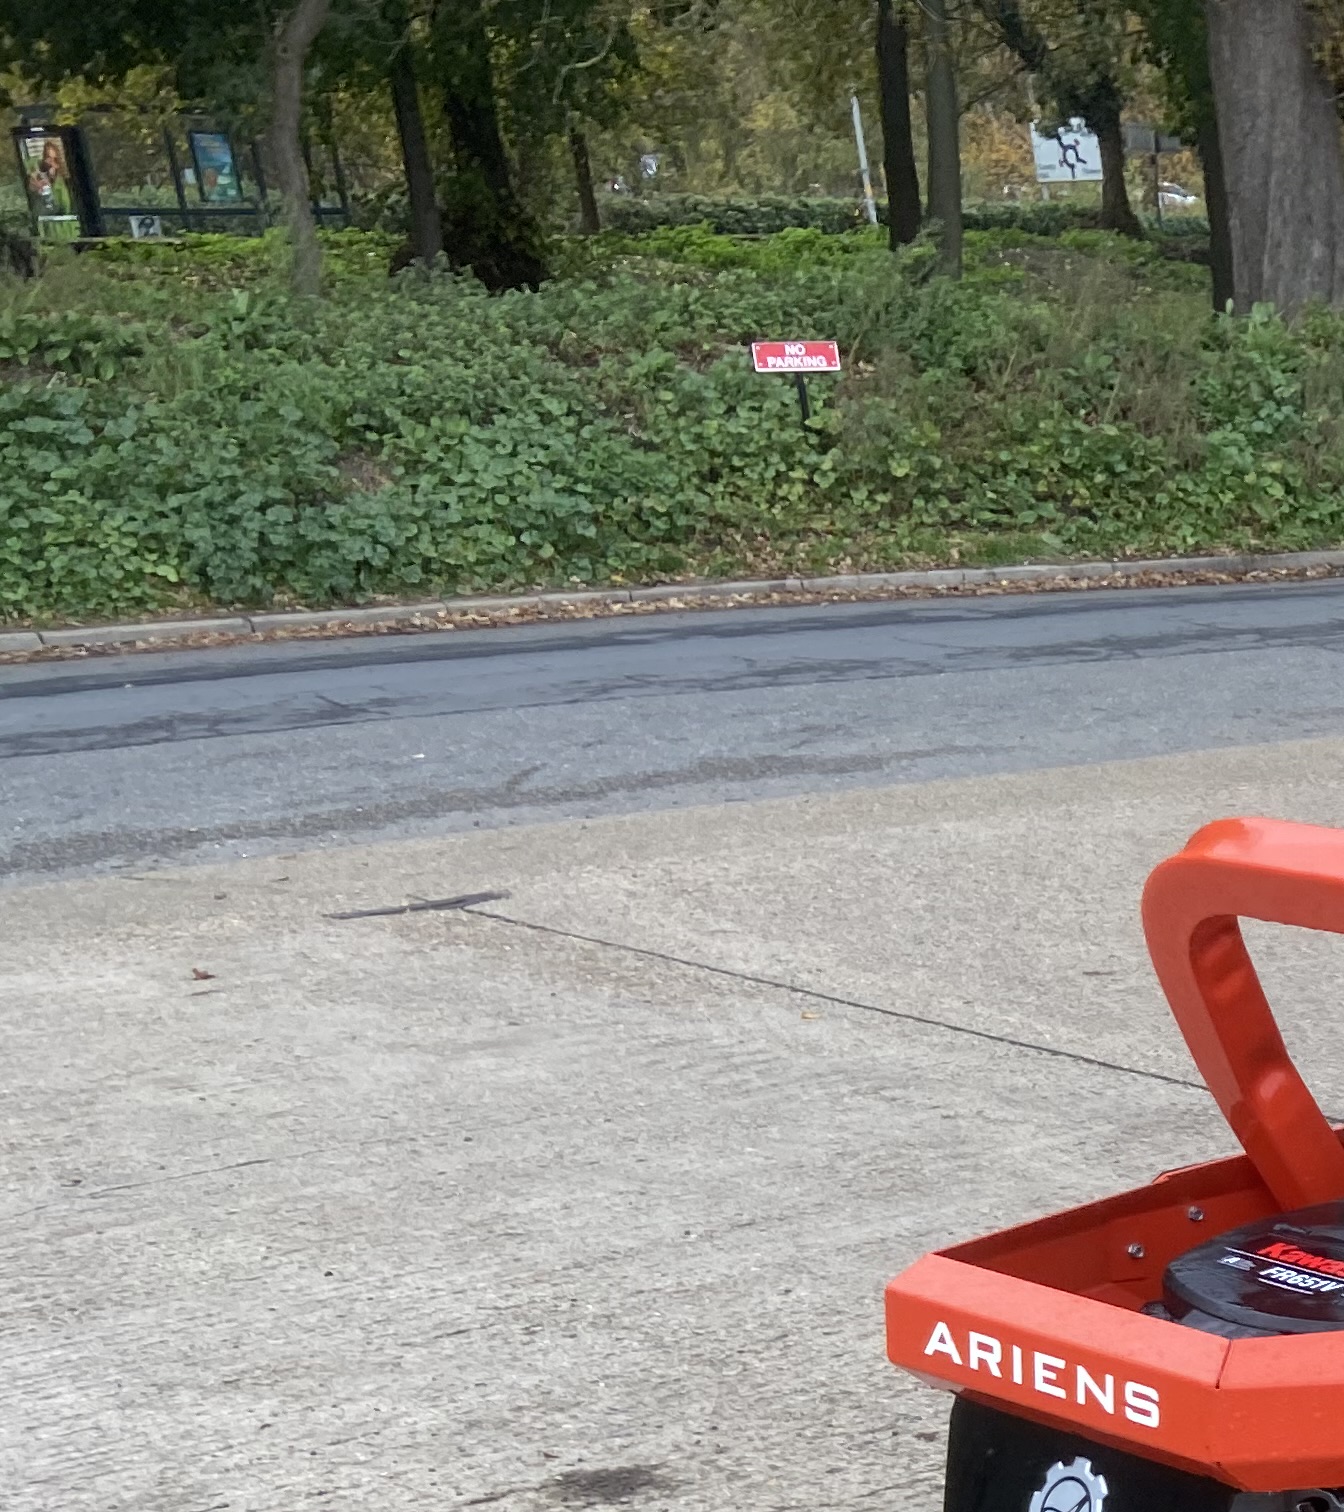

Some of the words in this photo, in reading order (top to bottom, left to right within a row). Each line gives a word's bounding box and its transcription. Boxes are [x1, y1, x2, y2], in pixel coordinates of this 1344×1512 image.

[784, 343, 806, 355] NO
[767, 356, 827, 368] PARKING
[924, 1321, 1160, 1429] ARIENS
